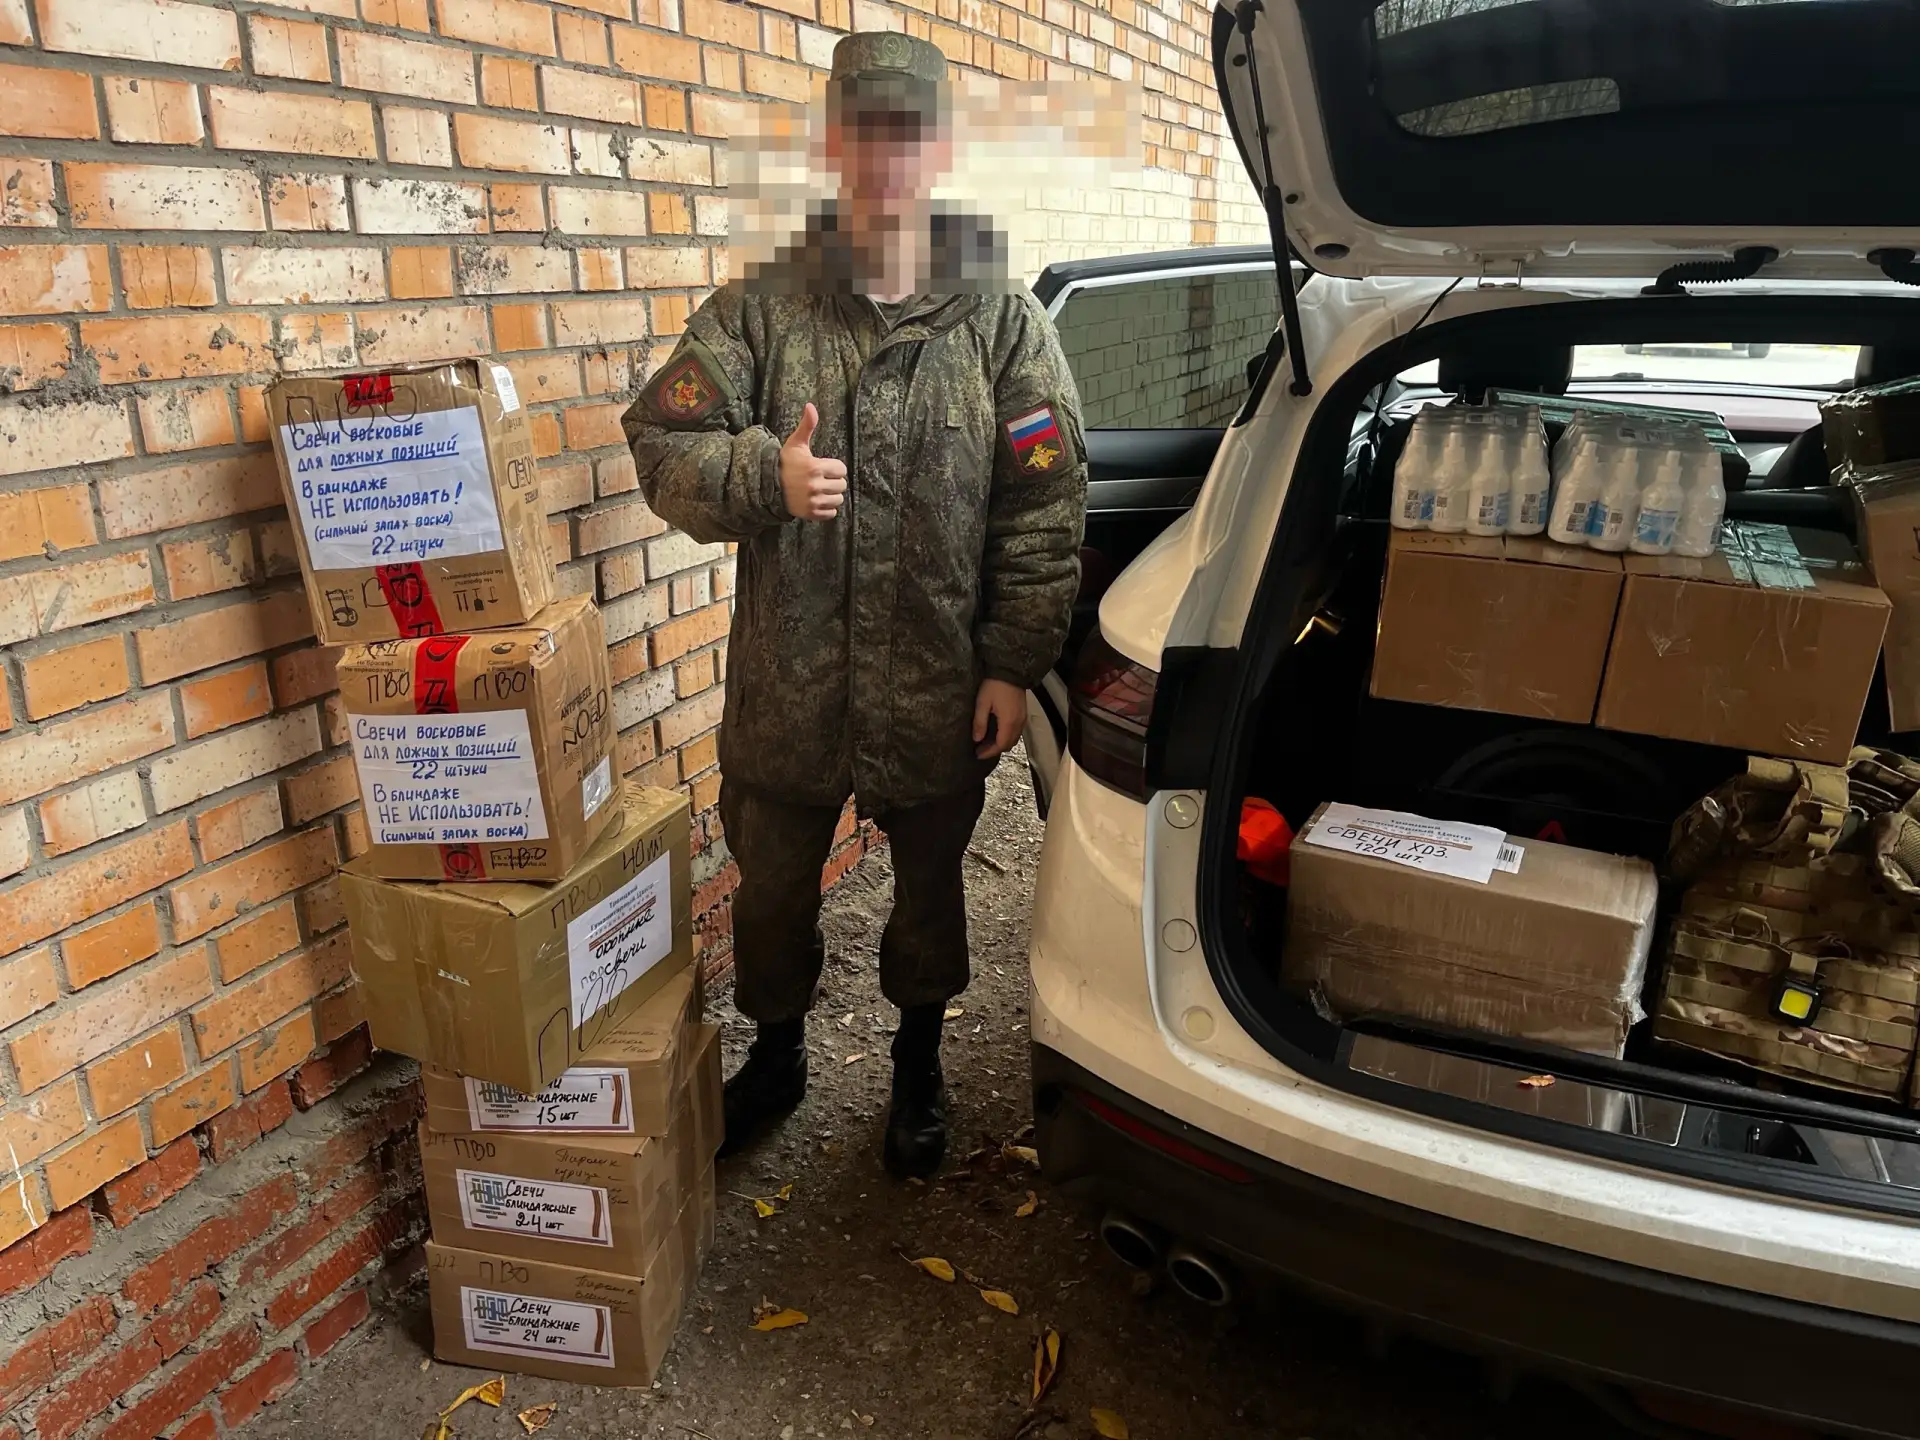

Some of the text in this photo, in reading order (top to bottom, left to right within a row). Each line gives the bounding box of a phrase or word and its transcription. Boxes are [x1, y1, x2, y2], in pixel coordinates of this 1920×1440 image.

[310, 498, 336, 519] НЕ
[372, 534, 396, 556] 22
[367, 672, 410, 704] ПВО
[474, 670, 526, 701] ПВО
[412, 761, 439, 780] 22
[373, 783, 387, 803] В
[378, 805, 401, 824] НЕ
[1326, 826, 1402, 849] СВЕЧИ
[622, 838, 645, 874] 40
[1354, 842, 1389, 856] 120
[552, 870, 602, 929] ПВО
[536, 1105, 560, 1125] 15
[454, 1138, 496, 1161] ПВО
[515, 1212, 541, 1233] 24
[522, 1329, 540, 1342] 24
